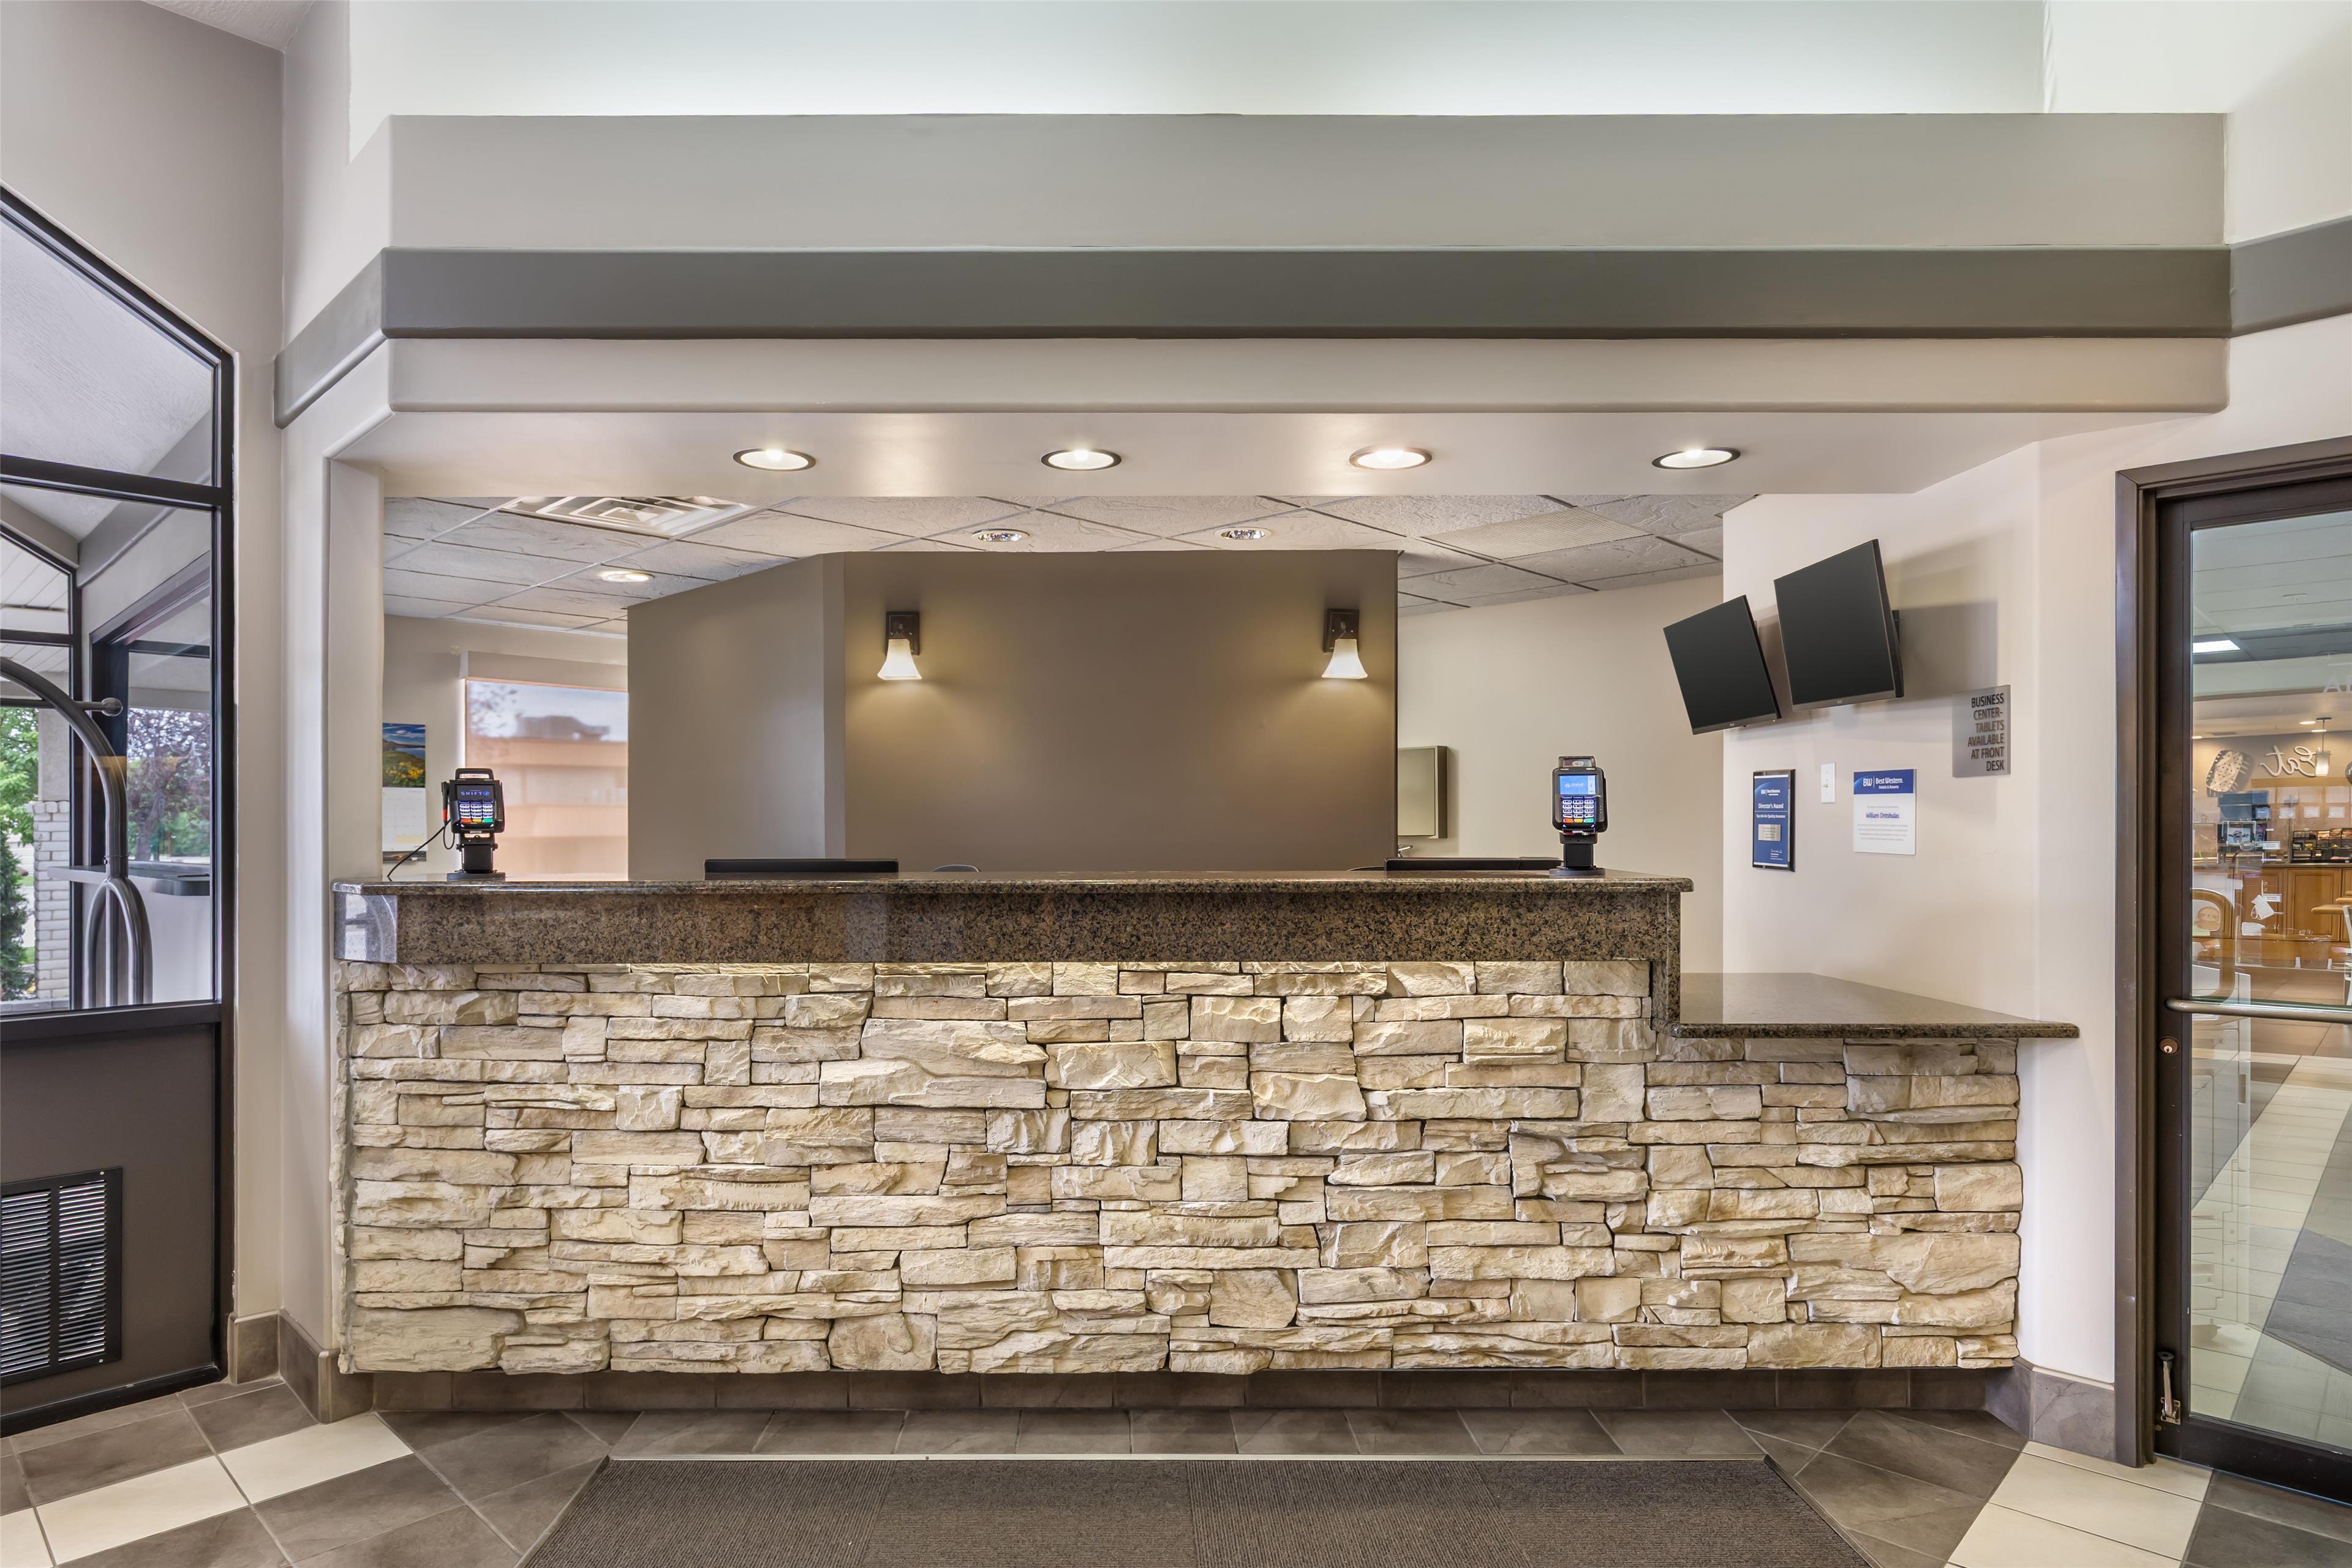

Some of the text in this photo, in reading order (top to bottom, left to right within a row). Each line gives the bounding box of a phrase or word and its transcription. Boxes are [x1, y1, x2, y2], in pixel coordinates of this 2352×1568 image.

[1971, 693, 2004, 708] BUSINESS
[1973, 707, 2003, 720] CENTER-
[1975, 720, 2004, 733] TABLETS
[1967, 733, 2004, 747] AVAILABLE
[1970, 746, 2004, 760] AT FRONT
[1986, 760, 2004, 772] DESK
[1863, 778, 1872, 786] BW
